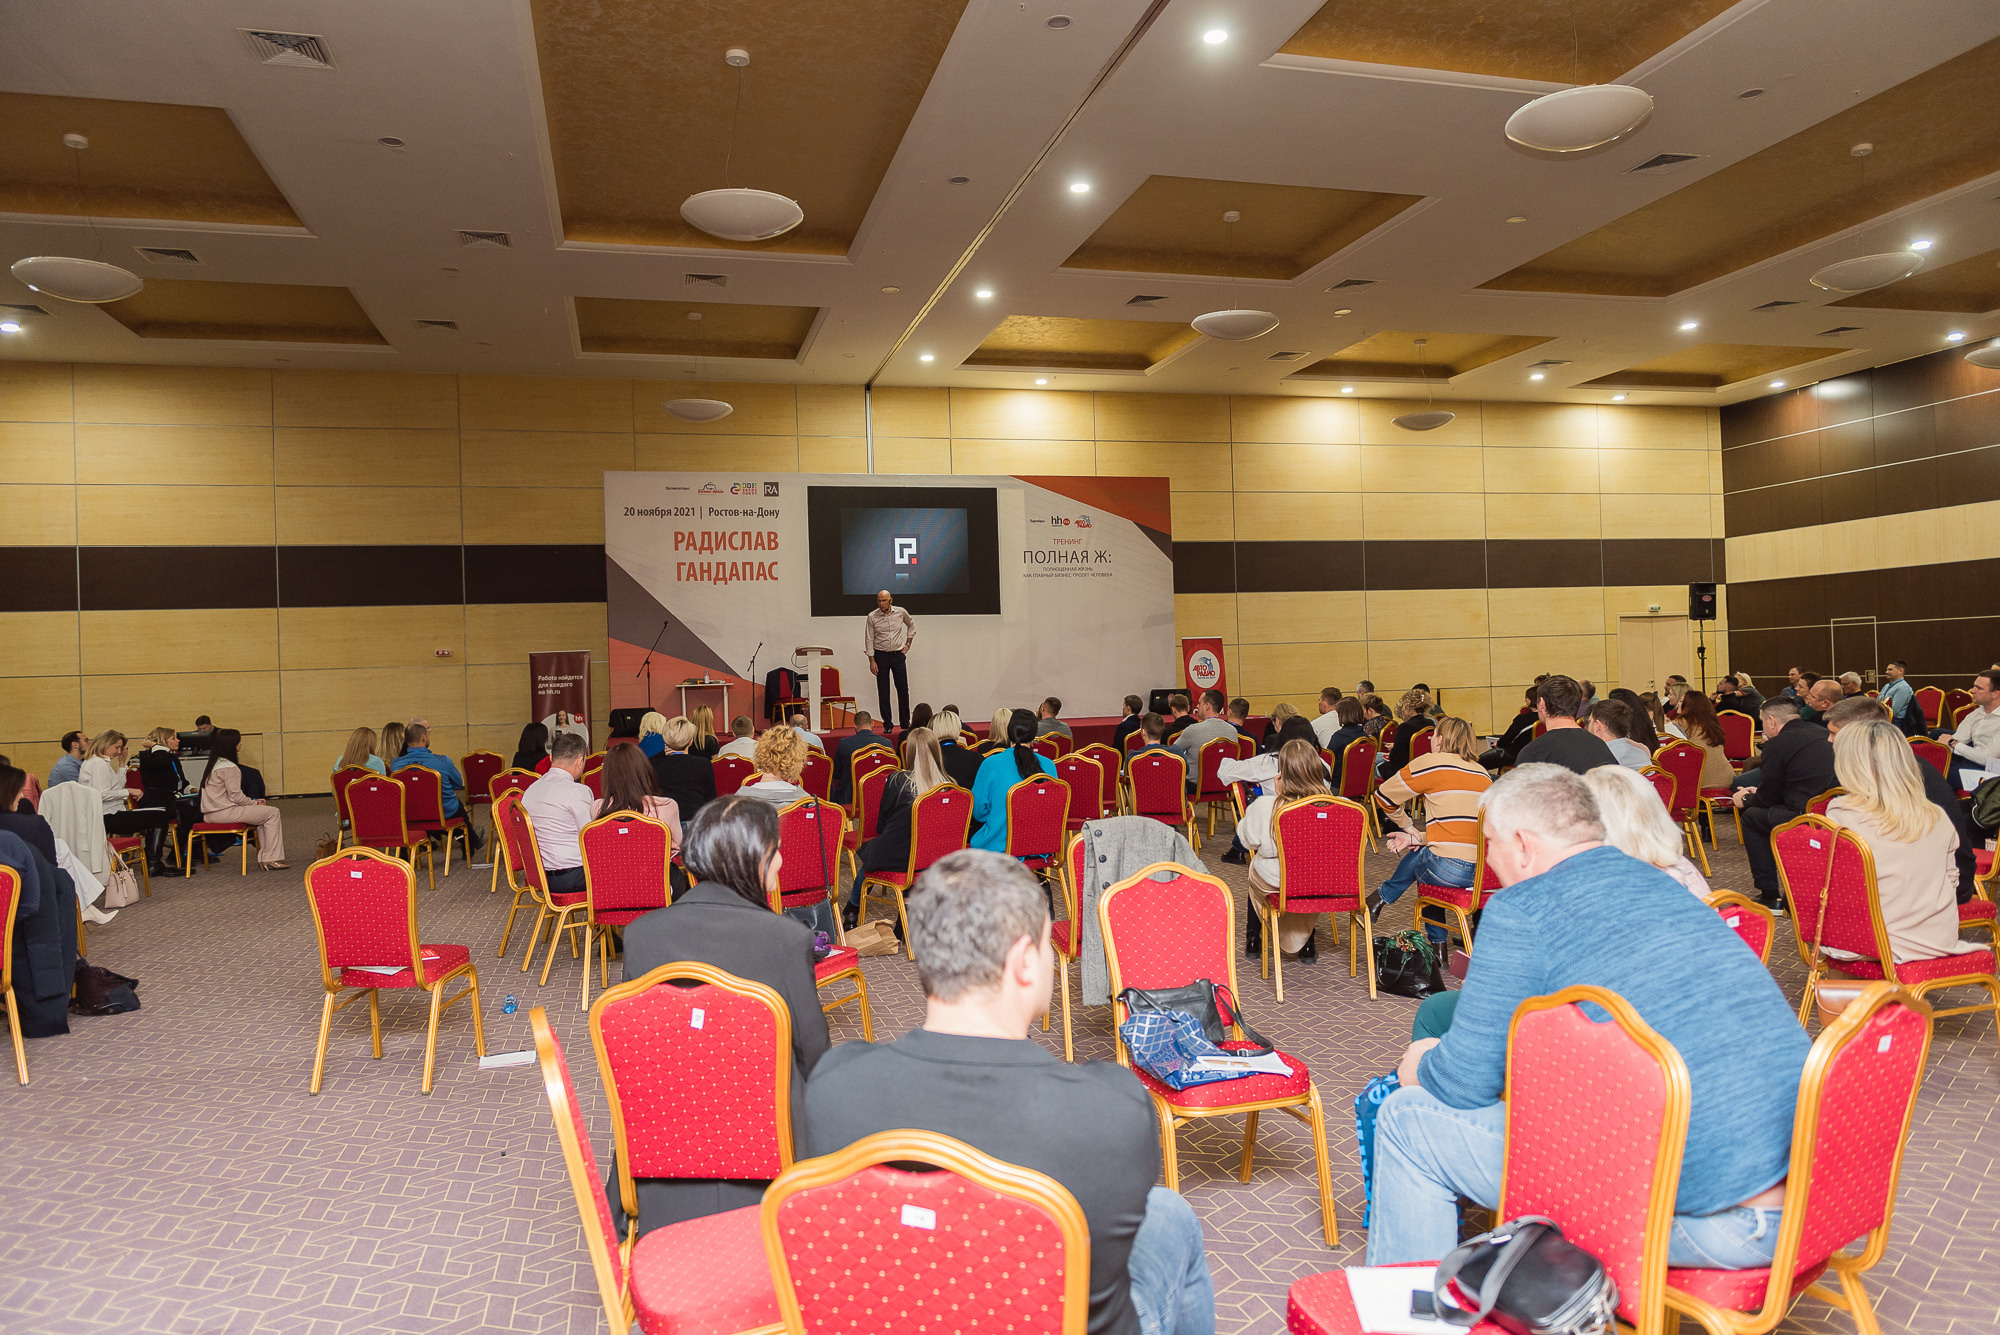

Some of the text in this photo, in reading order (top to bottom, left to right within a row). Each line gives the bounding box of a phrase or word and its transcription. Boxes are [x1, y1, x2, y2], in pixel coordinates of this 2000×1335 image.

[623, 507, 780, 519] 20 ноября 2021 Ростов-на-Дону
[1051, 515, 1062, 524] hh
[673, 531, 779, 555] РАДИСЛАВ
[1023, 550, 1112, 563] ПОЛНАЯ Ж:
[676, 561, 778, 585] ГАНДАПАС
